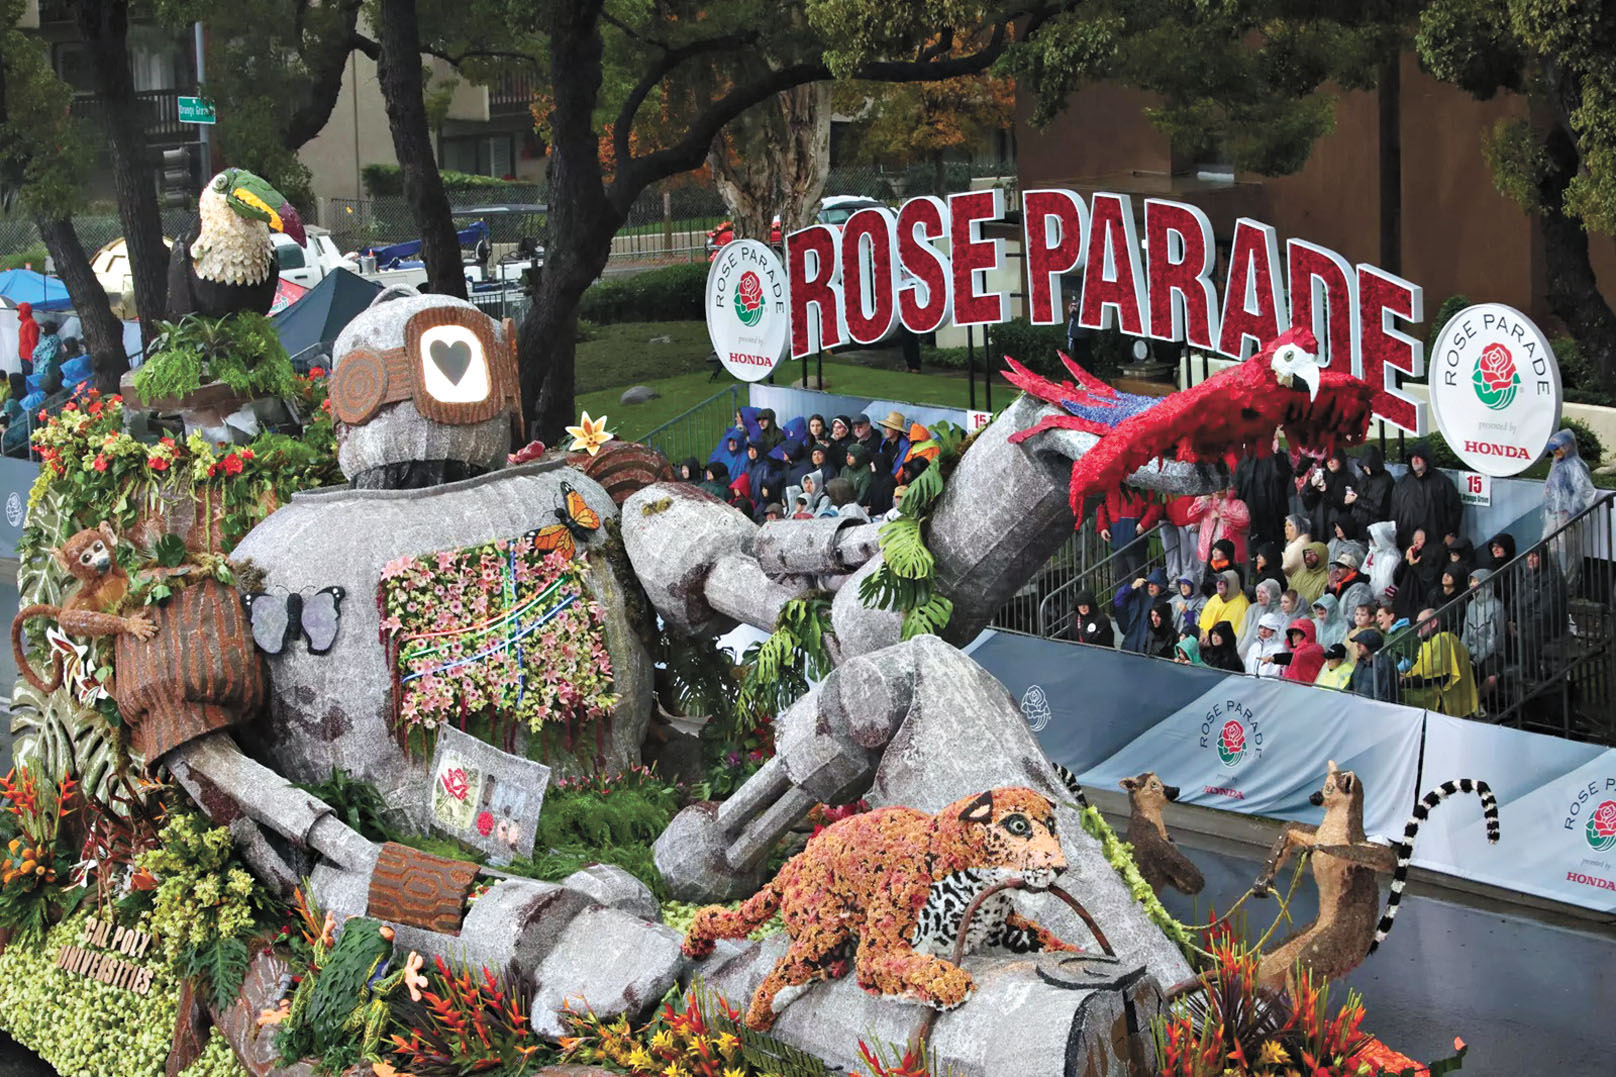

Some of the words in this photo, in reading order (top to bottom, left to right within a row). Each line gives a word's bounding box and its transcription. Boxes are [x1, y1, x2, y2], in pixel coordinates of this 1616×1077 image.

[716, 252, 738, 308] ROSE
[741, 246, 785, 314] PARADE
[786, 188, 1011, 360] ROSE
[1022, 188, 1428, 437] PARADE
[729, 352, 773, 368] HONDA
[1444, 320, 1477, 386] ROSE
[1483, 313, 1550, 395] PARADE
[973, 413, 987, 429] 15
[1464, 440, 1531, 460] HONDA
[1467, 475, 1482, 493] 15
[1200, 703, 1222, 748] ROSE
[1203, 785, 1245, 800] HONDA
[1564, 781, 1599, 830] ROSE
[1566, 872, 1616, 892] HONDA
[84, 917, 113, 948] CAL
[110, 925, 152, 959] POLY
[55, 944, 154, 995] UNIVERSITIES
